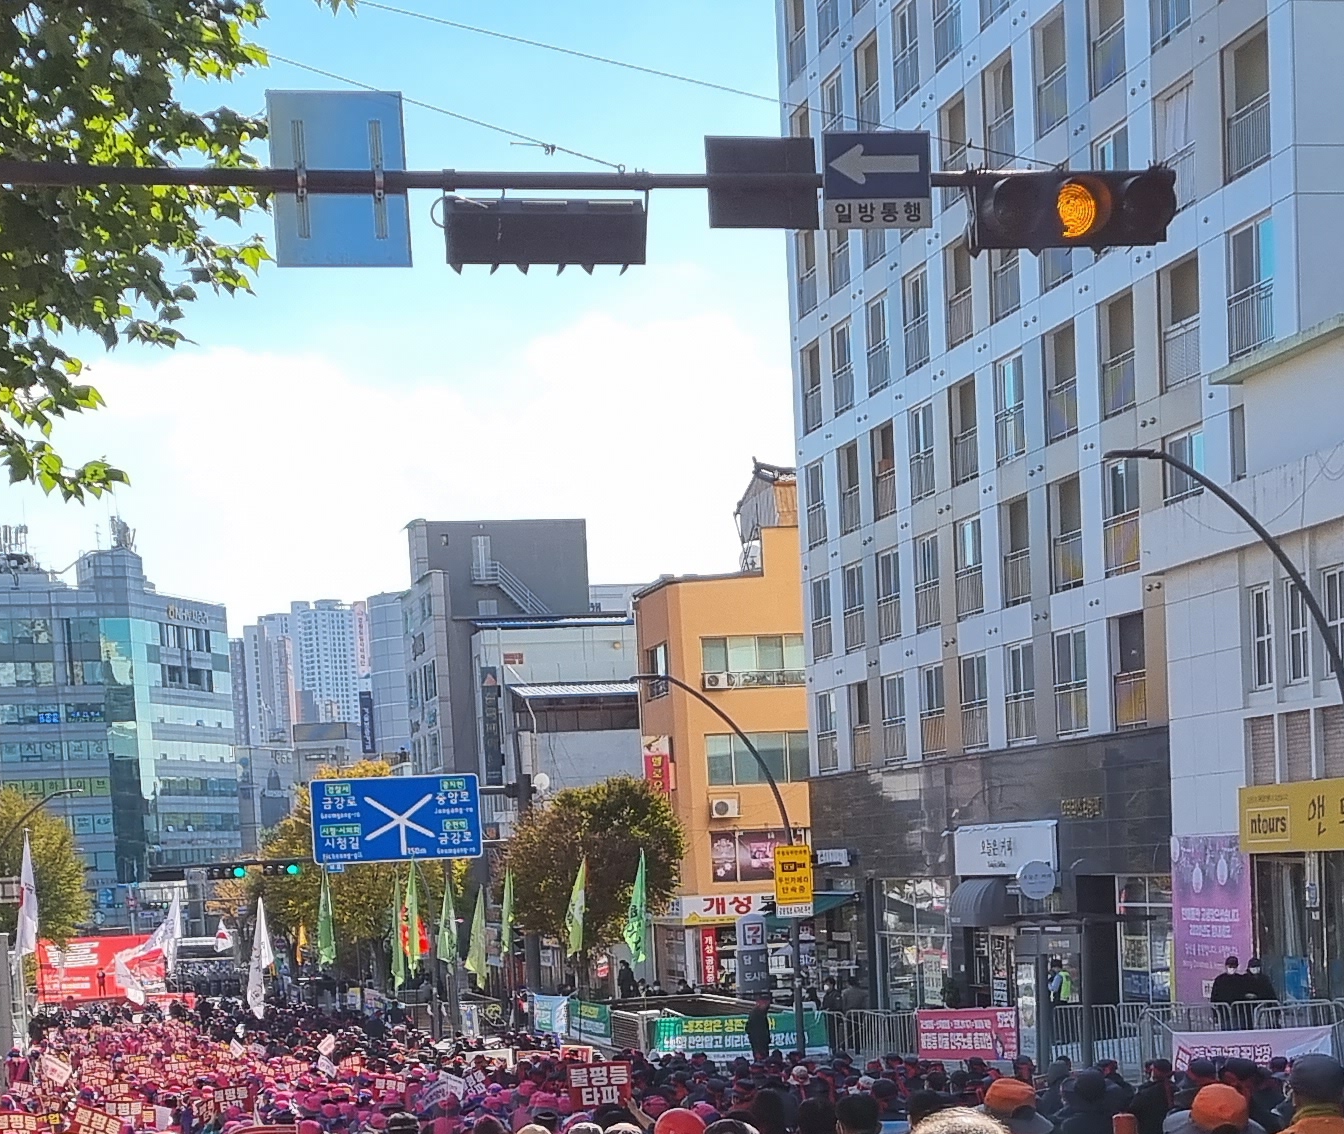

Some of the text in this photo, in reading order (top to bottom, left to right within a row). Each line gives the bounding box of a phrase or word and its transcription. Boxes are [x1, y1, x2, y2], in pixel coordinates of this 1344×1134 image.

[835, 201, 921, 224] 일방통행
[321, 796, 358, 810] 금강로
[435, 791, 471, 806] 중앙로
[1250, 812, 1287, 834] ntours
[324, 837, 360, 851] 시청길
[437, 831, 473, 845] 금강로
[703, 896, 752, 915] 개성
[570, 1065, 628, 1088] 불평등
[581, 1086, 621, 1106] 타파
